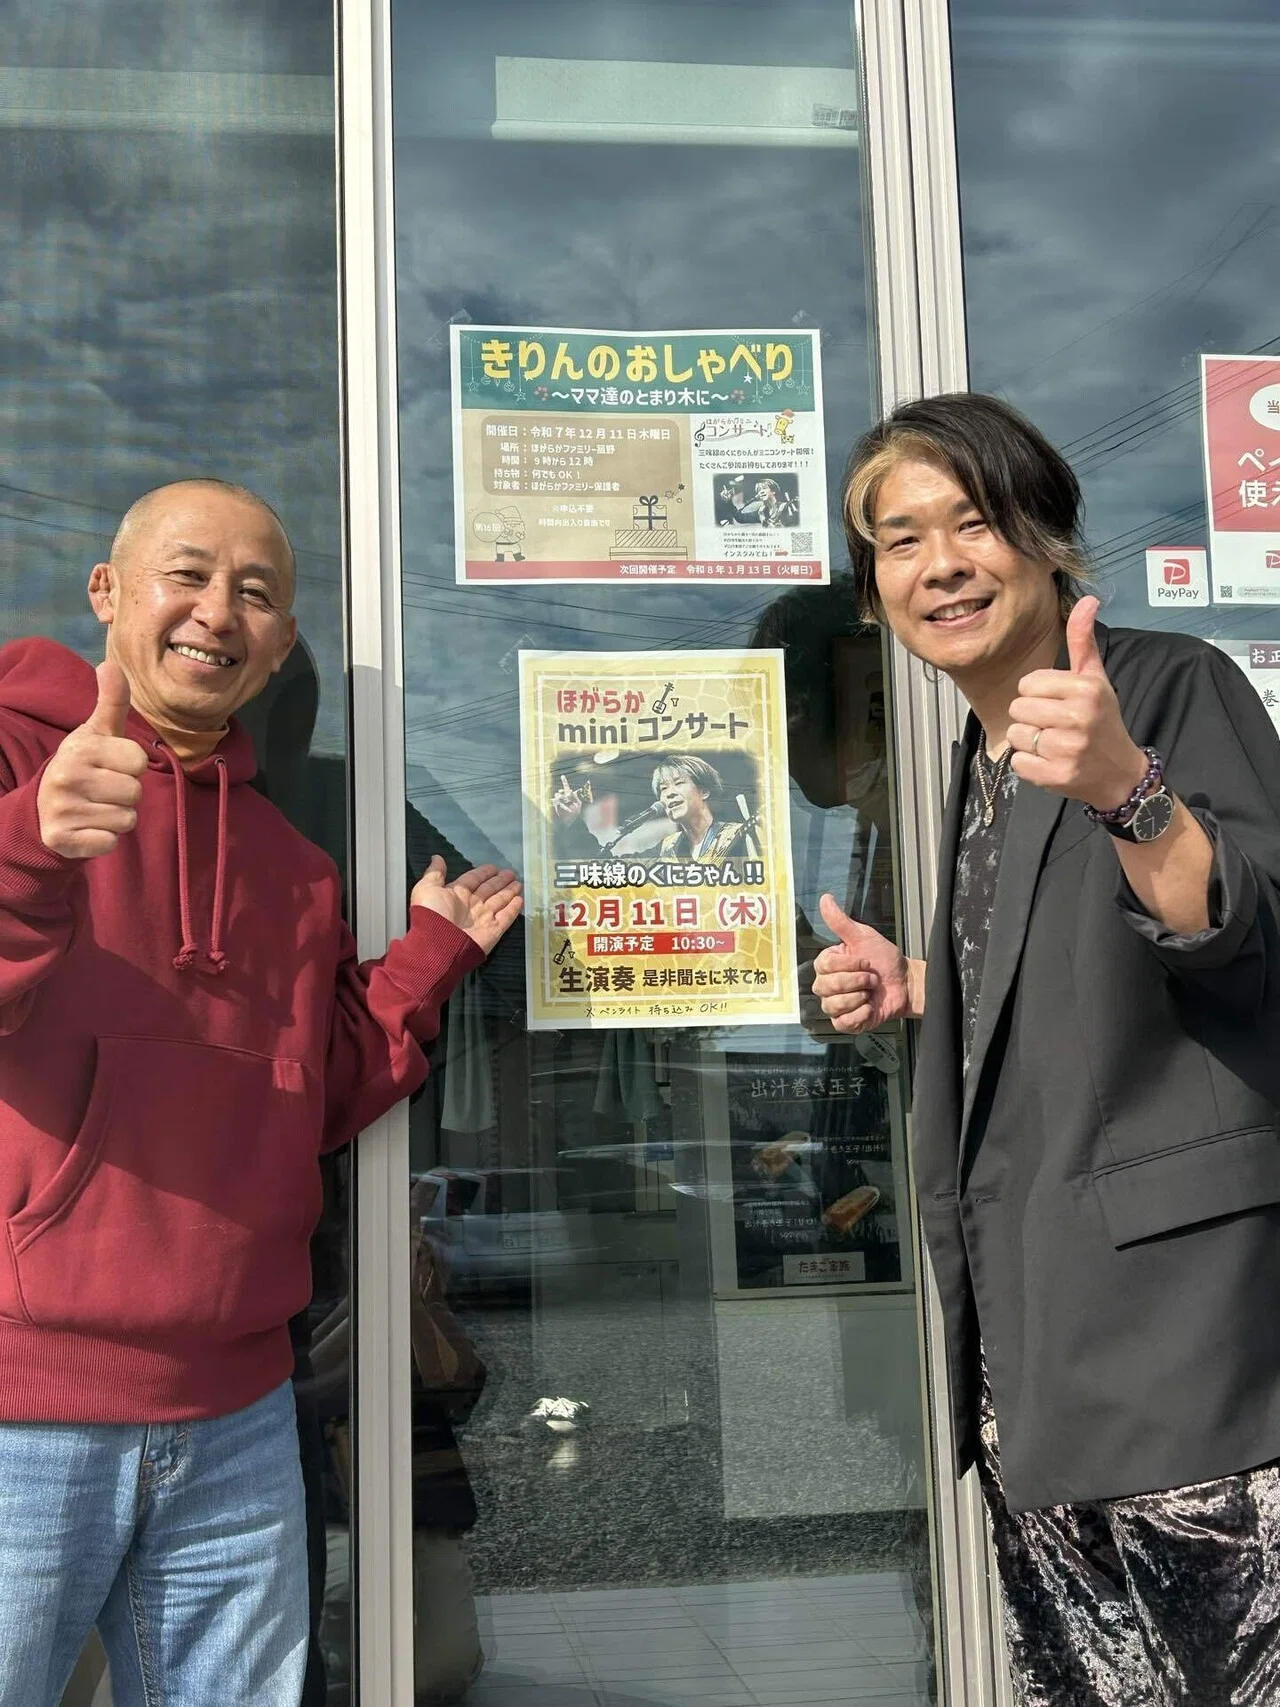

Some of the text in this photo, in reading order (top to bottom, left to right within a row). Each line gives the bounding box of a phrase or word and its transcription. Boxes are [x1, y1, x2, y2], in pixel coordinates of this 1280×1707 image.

[481, 339, 793, 383] きりんのおしゃべり
[619, 564, 676, 575] 次回開催予定
[1157, 587, 1199, 600] PayPay
[556, 687, 645, 715] ほがらか
[558, 712, 749, 745] mini コンサート
[593, 936, 656, 953] 開演予定
[558, 965, 768, 994] 生演奏 是非聞きに来てね
[649, 1003, 694, 1016] 持ち込み
[751, 1077, 867, 1098] 出汁巻き玉子
